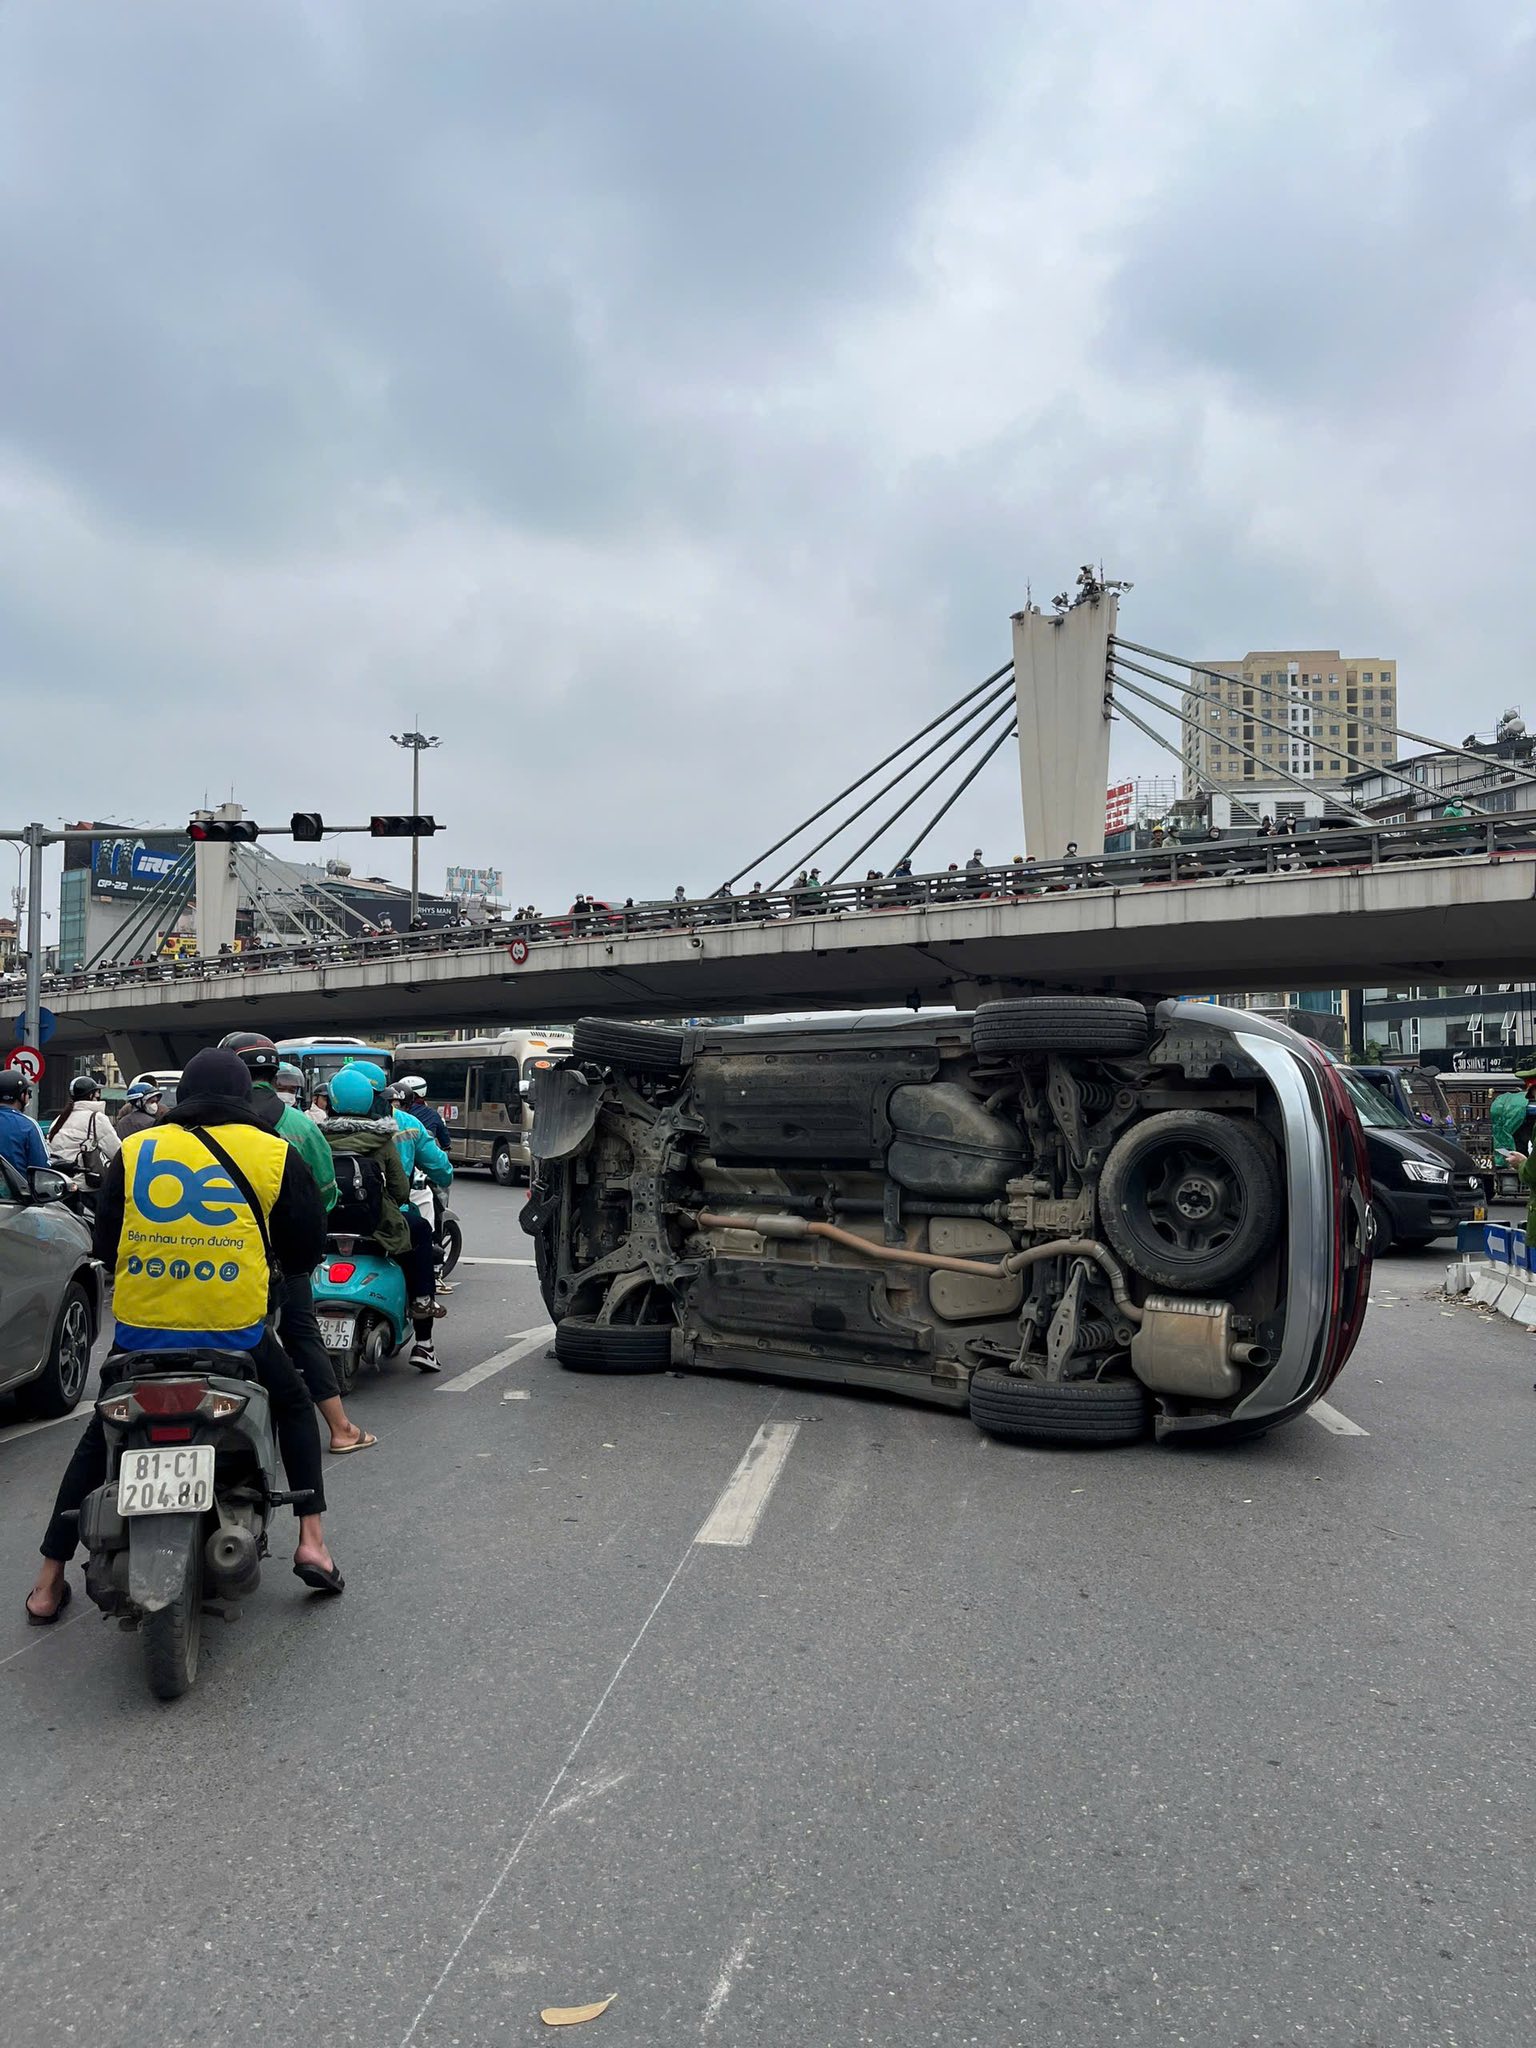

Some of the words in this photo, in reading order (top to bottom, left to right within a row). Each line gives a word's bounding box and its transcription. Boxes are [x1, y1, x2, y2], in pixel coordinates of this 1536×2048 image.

[97, 879, 129, 891] GP-22
[448, 878, 500, 894] LILY
[436, 907, 452, 915] MAN
[1490, 1058, 1501, 1066] 407
[133, 1139, 249, 1226] be
[128, 1230, 147, 1242] Bên
[149, 1233, 178, 1244] nhau
[181, 1235, 204, 1248] trọn
[207, 1236, 244, 1250] đường
[136, 1451, 198, 1480] 81-C1
[125, 1480, 207, 1510] 204.80
